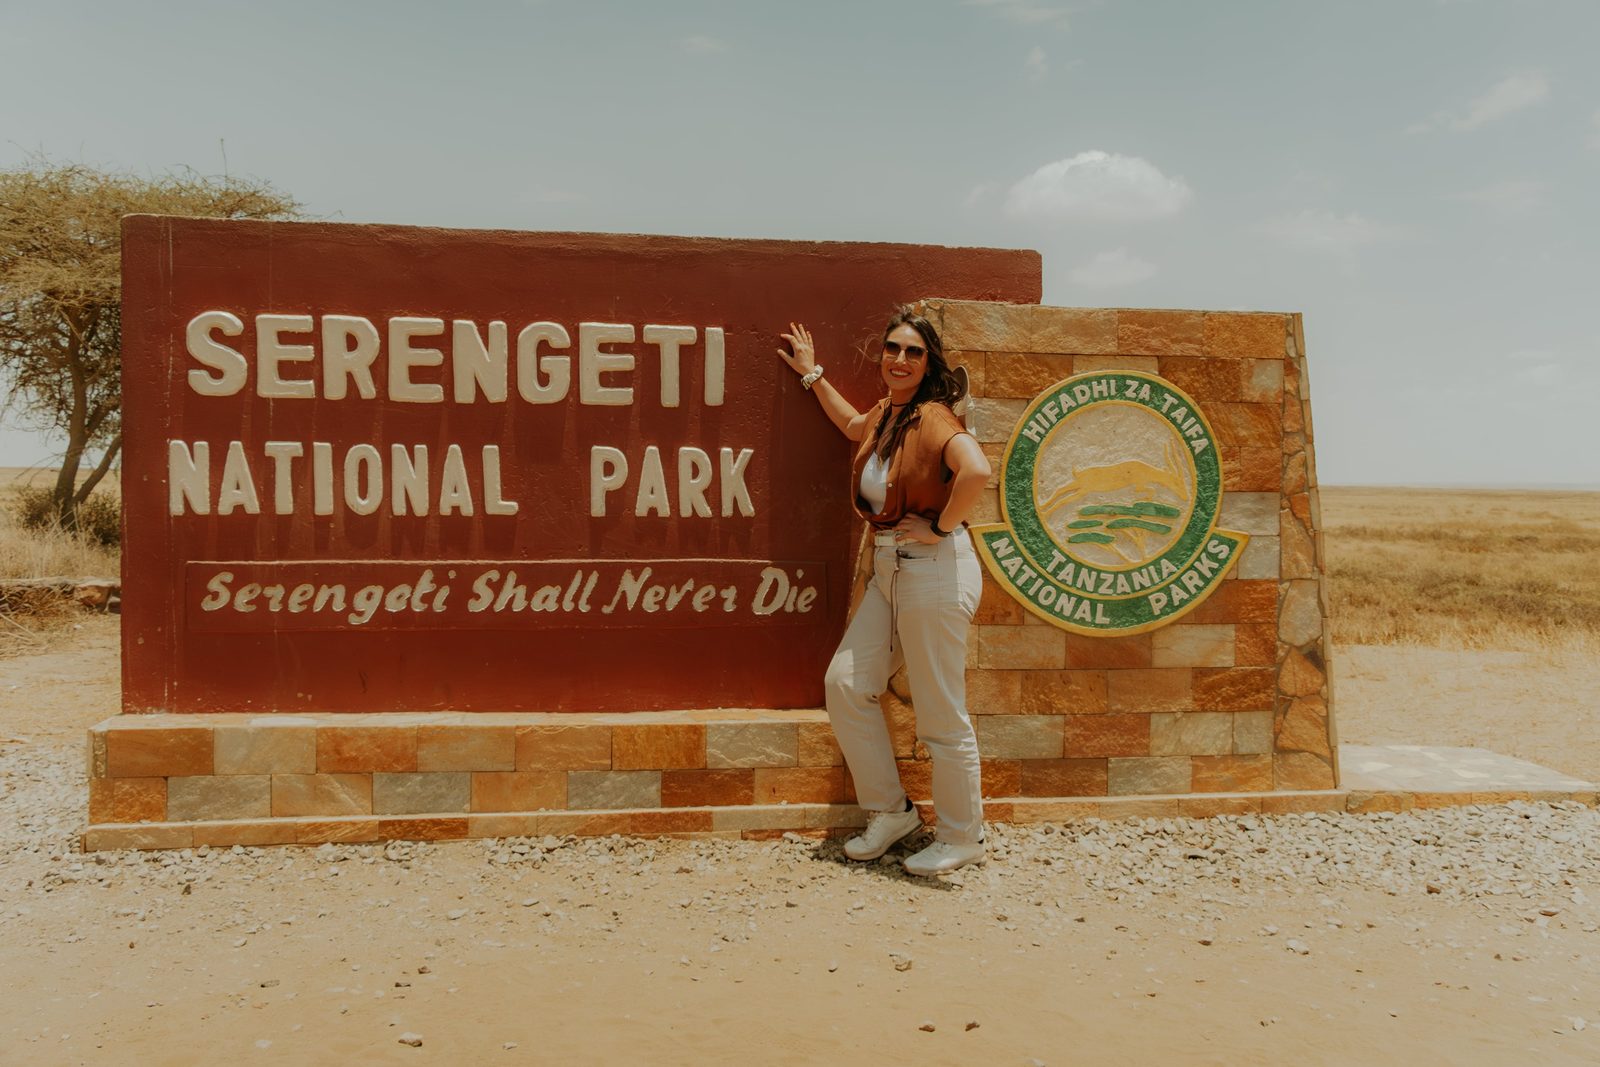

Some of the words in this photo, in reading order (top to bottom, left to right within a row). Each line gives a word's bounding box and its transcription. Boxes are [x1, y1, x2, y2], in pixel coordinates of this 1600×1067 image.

[186, 311, 724, 407] SERENGETI
[1022, 380, 1117, 445] HIFADHI
[1125, 379, 1151, 401] ZA
[1160, 393, 1209, 455] TAIFA
[169, 440, 518, 517] NATIONAL
[590, 445, 755, 518] PARK
[201, 569, 456, 625] Serengeti
[468, 569, 598, 614] Shall
[601, 568, 737, 615] Never
[751, 567, 817, 616] Die
[991, 537, 1110, 625] NATIONAL
[1148, 539, 1230, 616] PARKS
[1046, 549, 1178, 595] TANZANIA
